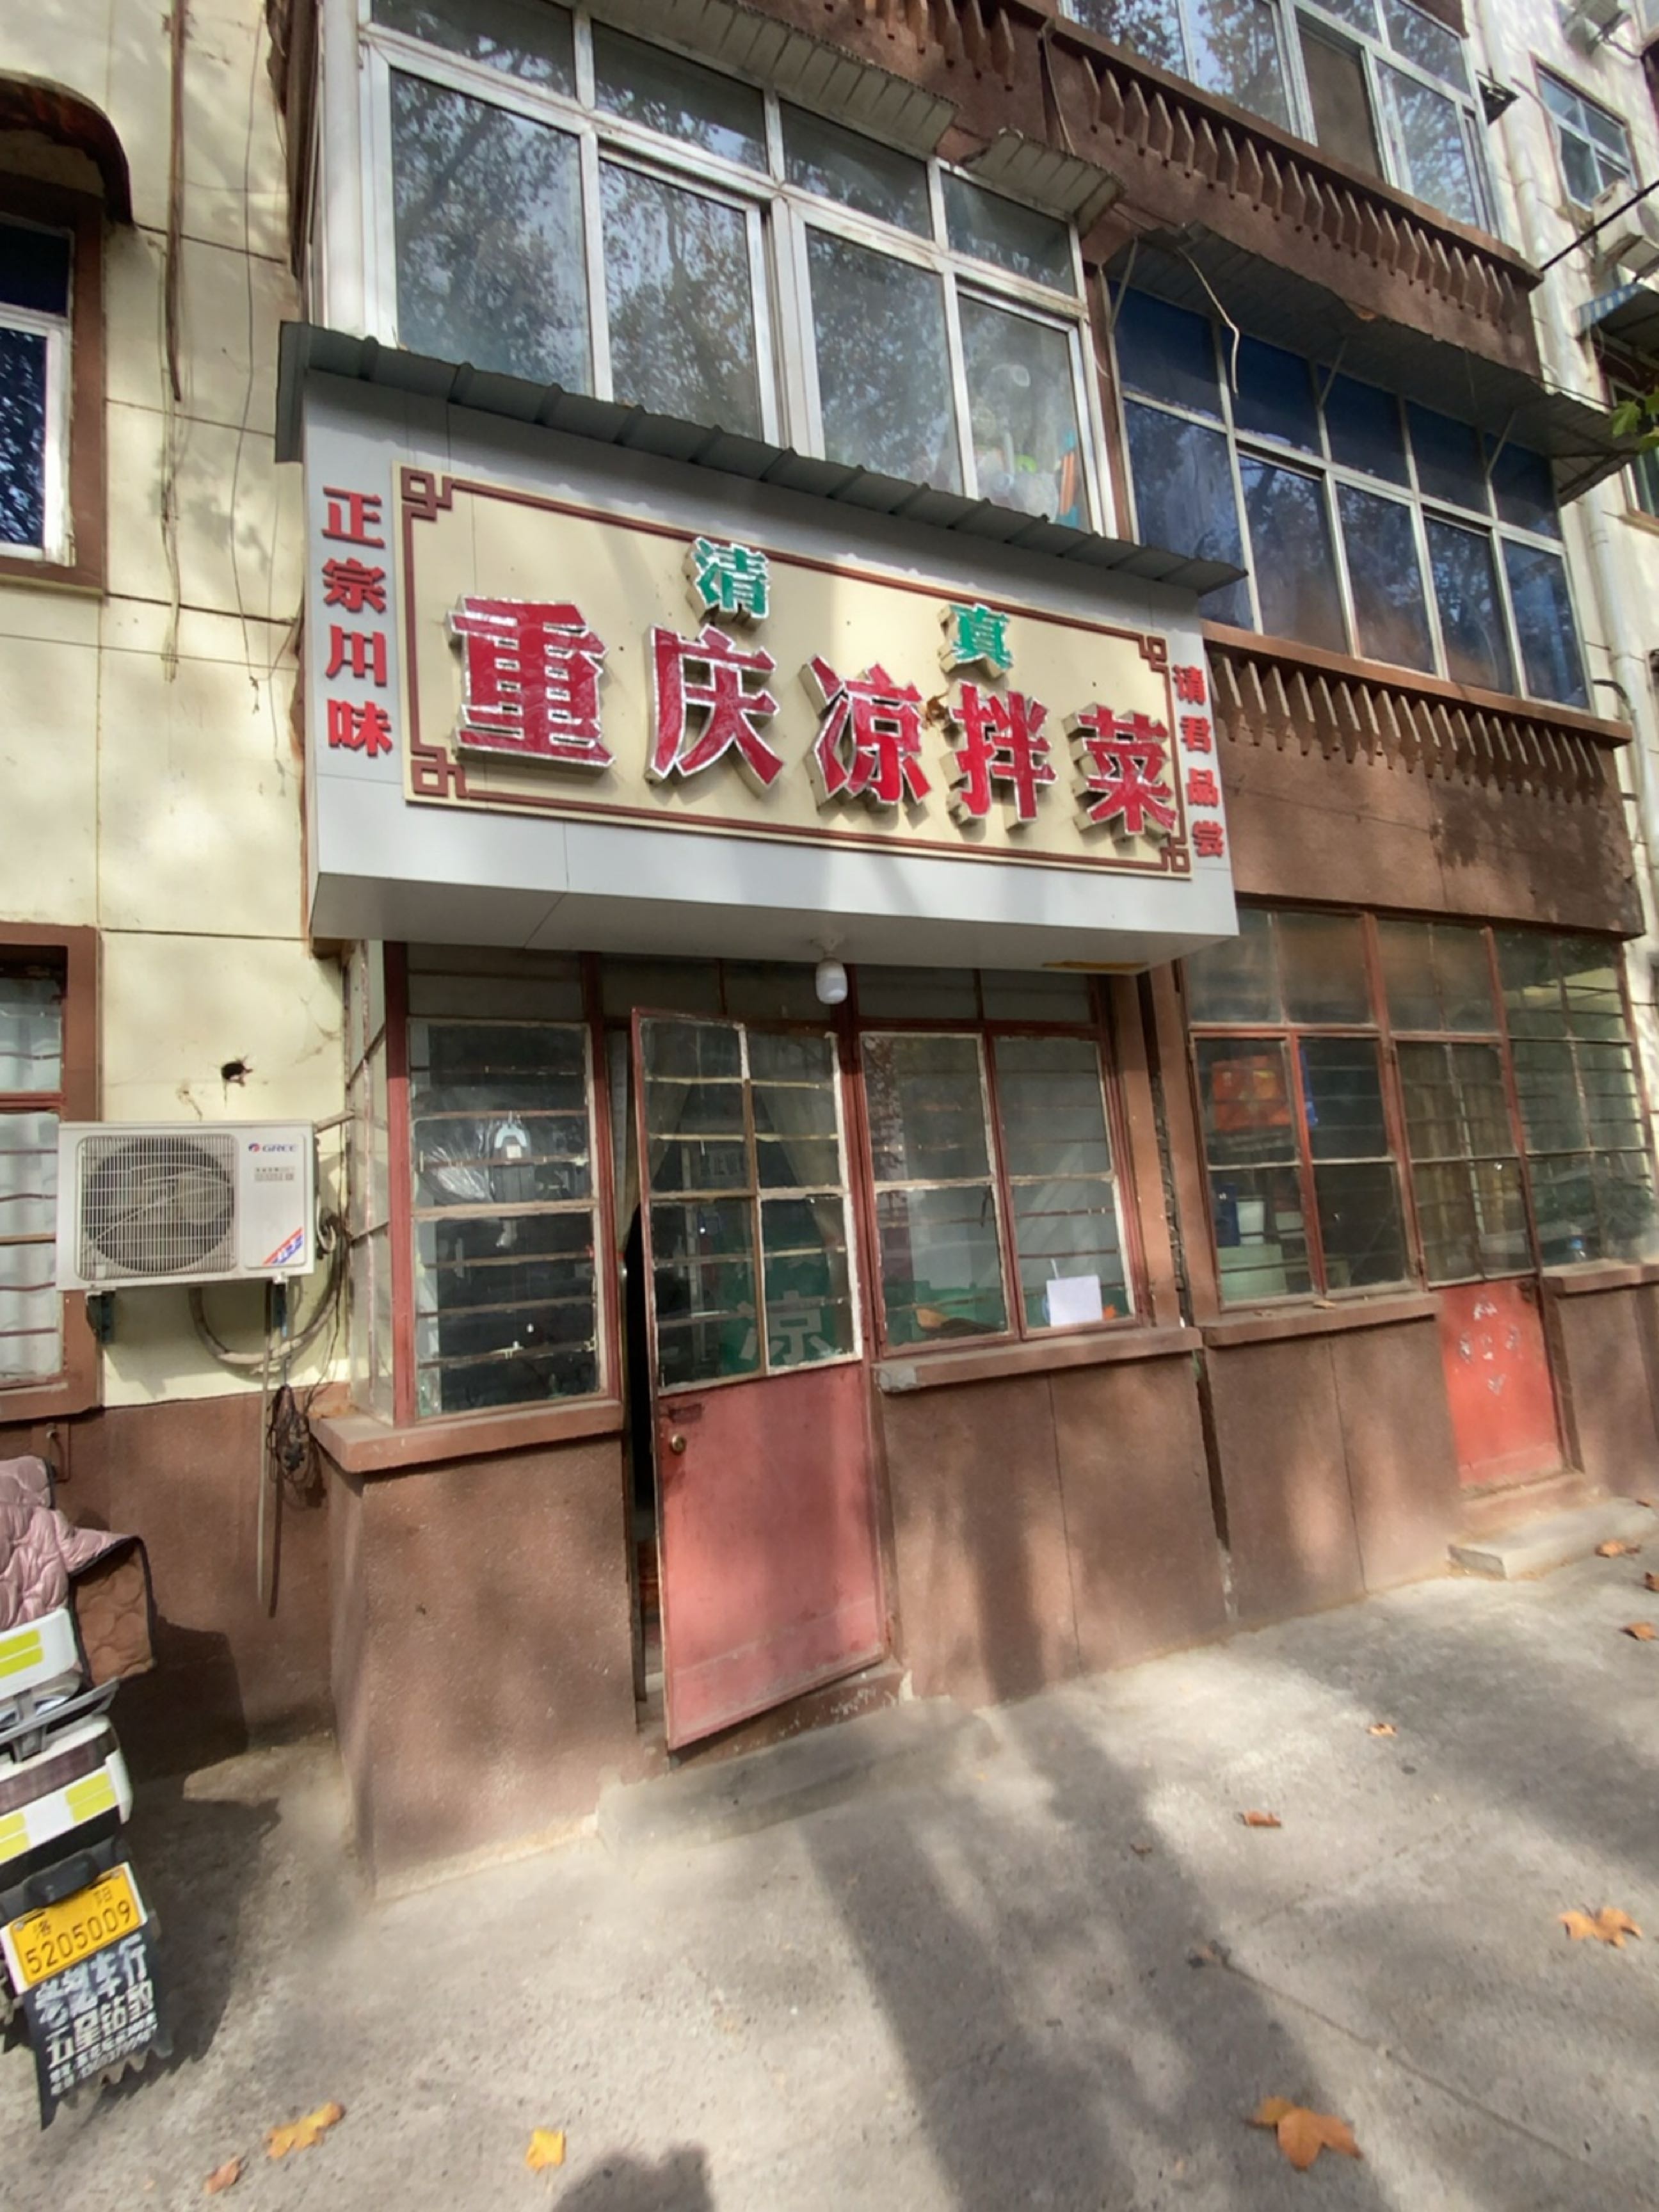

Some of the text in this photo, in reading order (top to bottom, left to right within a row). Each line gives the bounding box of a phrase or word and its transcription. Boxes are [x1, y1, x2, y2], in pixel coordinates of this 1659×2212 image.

[321, 485, 392, 757] 正宗川味
[449, 593, 1178, 834] 重庆凉拌菜
[26, 1899, 132, 1976] 5205009
